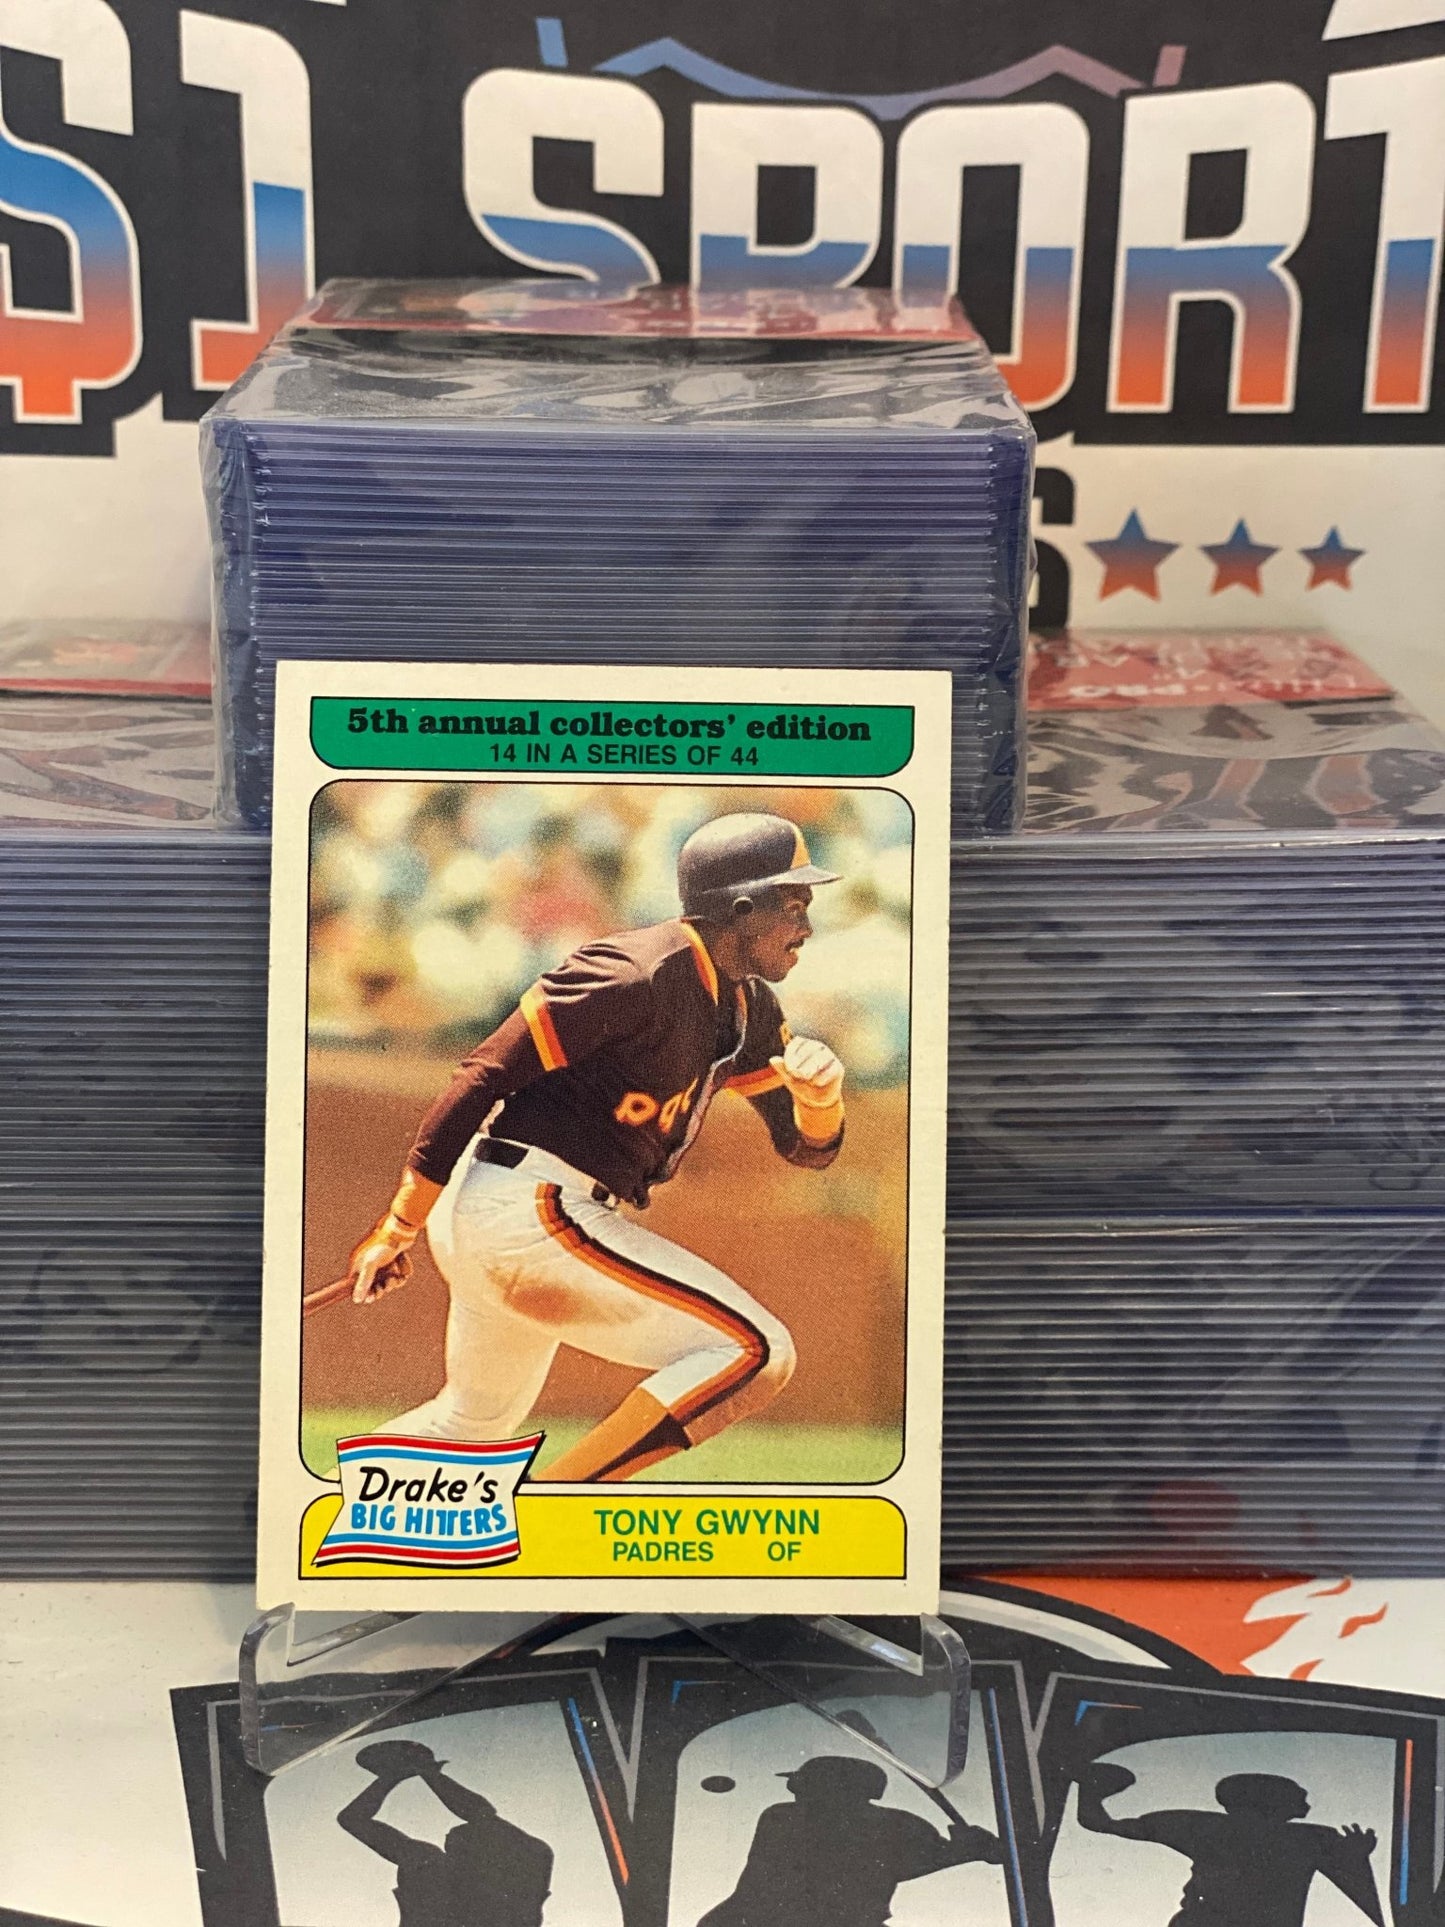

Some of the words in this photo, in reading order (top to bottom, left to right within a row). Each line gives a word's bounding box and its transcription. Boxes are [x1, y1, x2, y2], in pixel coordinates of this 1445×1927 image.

[347, 707, 409, 734] 5th
[418, 710, 541, 736] annual
[549, 711, 737, 739] collectors'
[746, 714, 872, 742] edition
[490, 743, 517, 763] 14
[526, 743, 551, 764] IN
[560, 744, 579, 764] A
[587, 744, 677, 766] SERIES
[687, 746, 722, 766] OF
[730, 747, 759, 767] 44
[358, 1466, 499, 1504] Drake's
[351, 1503, 397, 1531] BIG
[404, 1503, 507, 1536] HITTERS
[593, 1509, 682, 1536] TONY
[696, 1509, 820, 1536] GWYNN
[613, 1541, 714, 1562] PADRES
[767, 1541, 801, 1562] OF
